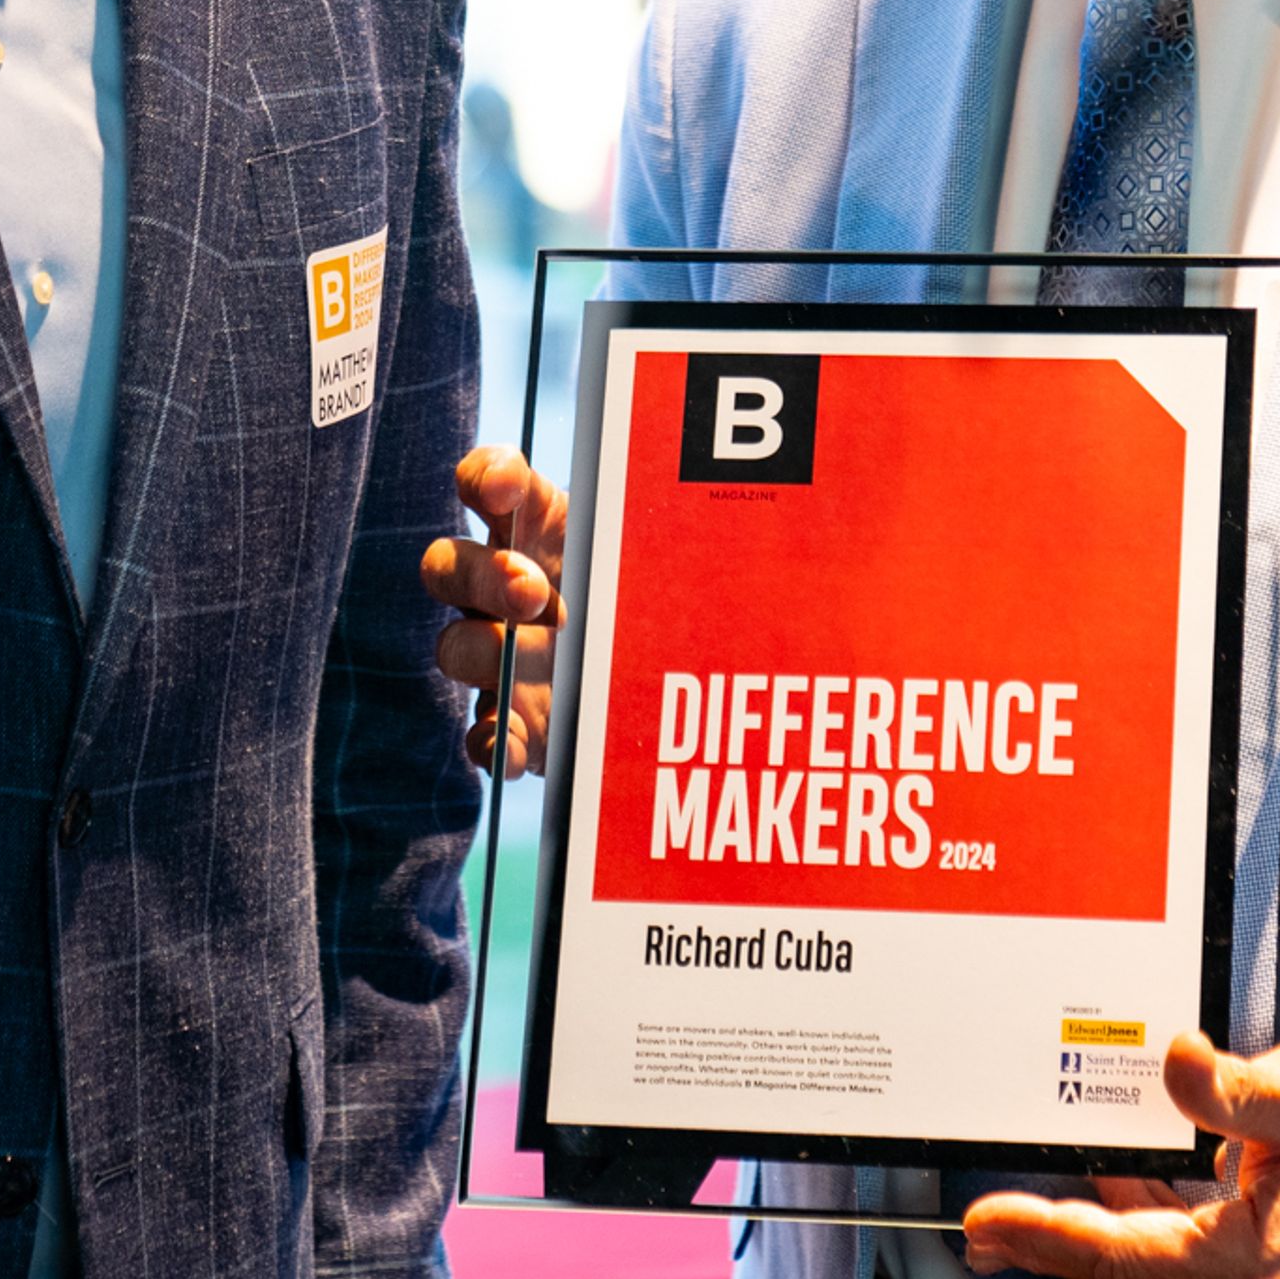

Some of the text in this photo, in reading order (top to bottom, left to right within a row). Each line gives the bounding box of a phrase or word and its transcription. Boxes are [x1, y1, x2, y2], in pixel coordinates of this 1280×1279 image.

[321, 270, 346, 329] B
[319, 381, 366, 422] BRANDT
[713, 376, 784, 460] B
[709, 490, 778, 503] MAGAZINE
[657, 671, 1079, 777] DIFFERENCE
[650, 766, 997, 872] MAKERS 2024
[644, 924, 854, 973] Richard Cuba
[637, 1023, 663, 1032] Some
[666, 1025, 680, 1033] are
[683, 1026, 716, 1035] movers
[719, 1026, 737, 1035] and
[831, 1030, 880, 1042] individuals
[636, 1036, 667, 1045] known
[668, 1037, 677, 1046] in
[679, 1037, 694, 1046] the
[751, 1040, 783, 1050] Others
[785, 1042, 808, 1051] work
[810, 1043, 841, 1054] quietly
[843, 1044, 875, 1054] behind
[876, 1046, 892, 1055] the
[670, 1051, 704, 1062] making
[705, 1052, 741, 1063] positive
[743, 1053, 804, 1065] contributions
[807, 1056, 817, 1065] to
[819, 1057, 840, 1066] their
[842, 1057, 892, 1068] businesses
[1086, 1053, 1160, 1068] Saint Francis
[699, 1064, 738, 1075] Whether
[795, 1069, 804, 1077] or
[807, 1069, 831, 1080] quiet
[649, 1076, 665, 1085] call
[666, 1076, 692, 1086] these
[693, 1077, 742, 1088] individuals
[745, 1079, 751, 1088] B
[753, 1079, 797, 1091] Magazine
[799, 1081, 847, 1093] Difference
[1085, 1085, 1142, 1097] ARNOLD
[1085, 1095, 1141, 1106] INSURANCE
